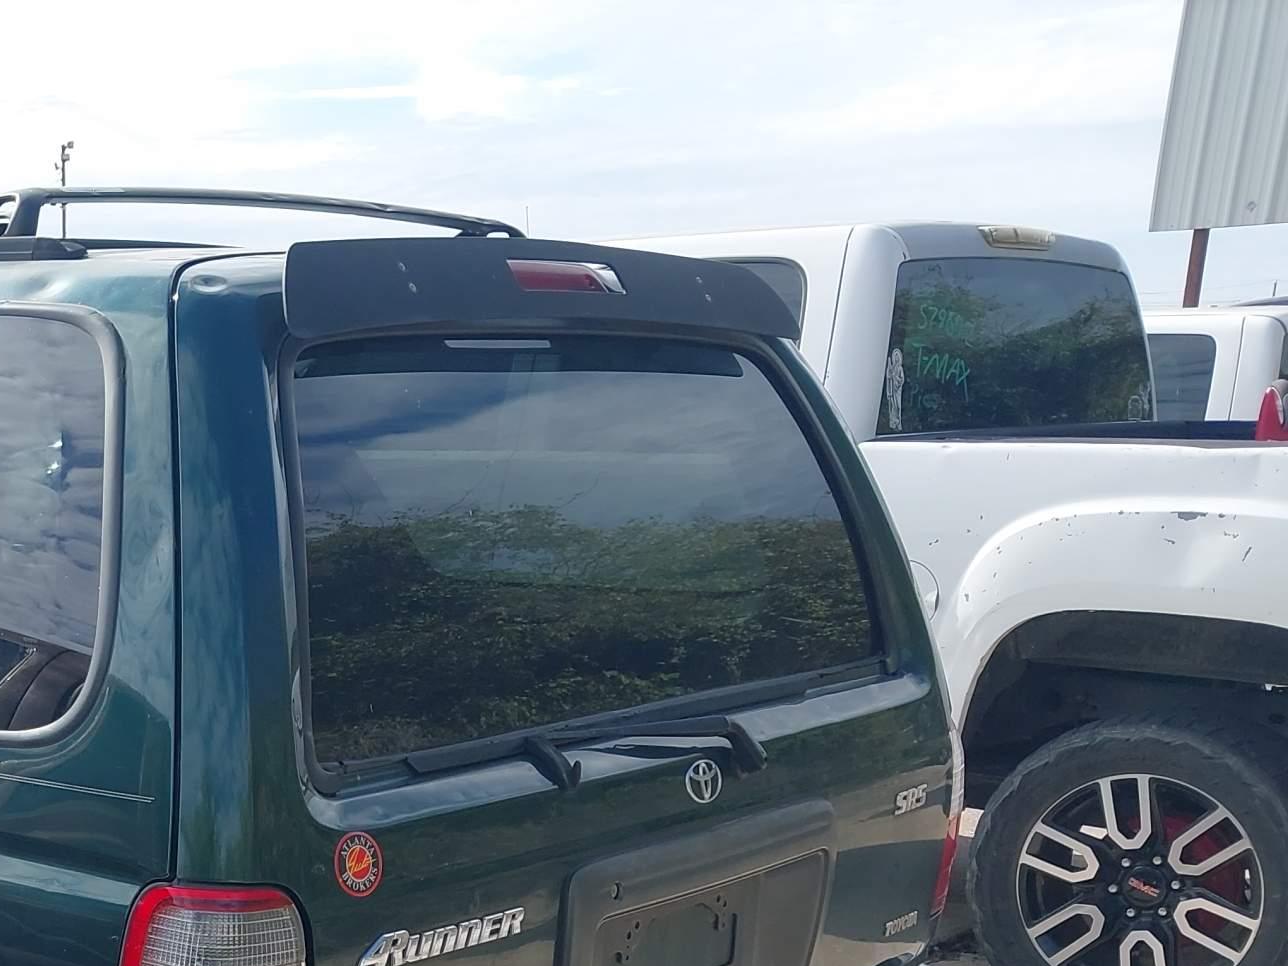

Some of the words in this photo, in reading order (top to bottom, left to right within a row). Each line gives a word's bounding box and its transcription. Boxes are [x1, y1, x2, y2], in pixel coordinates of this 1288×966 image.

[894, 783, 928, 816] SR5
[341, 836, 375, 858] ATLANTA
[342, 867, 378, 891] BROKERS
[1127, 877, 1161, 897] GMC
[884, 910, 918, 937] TOYOTA
